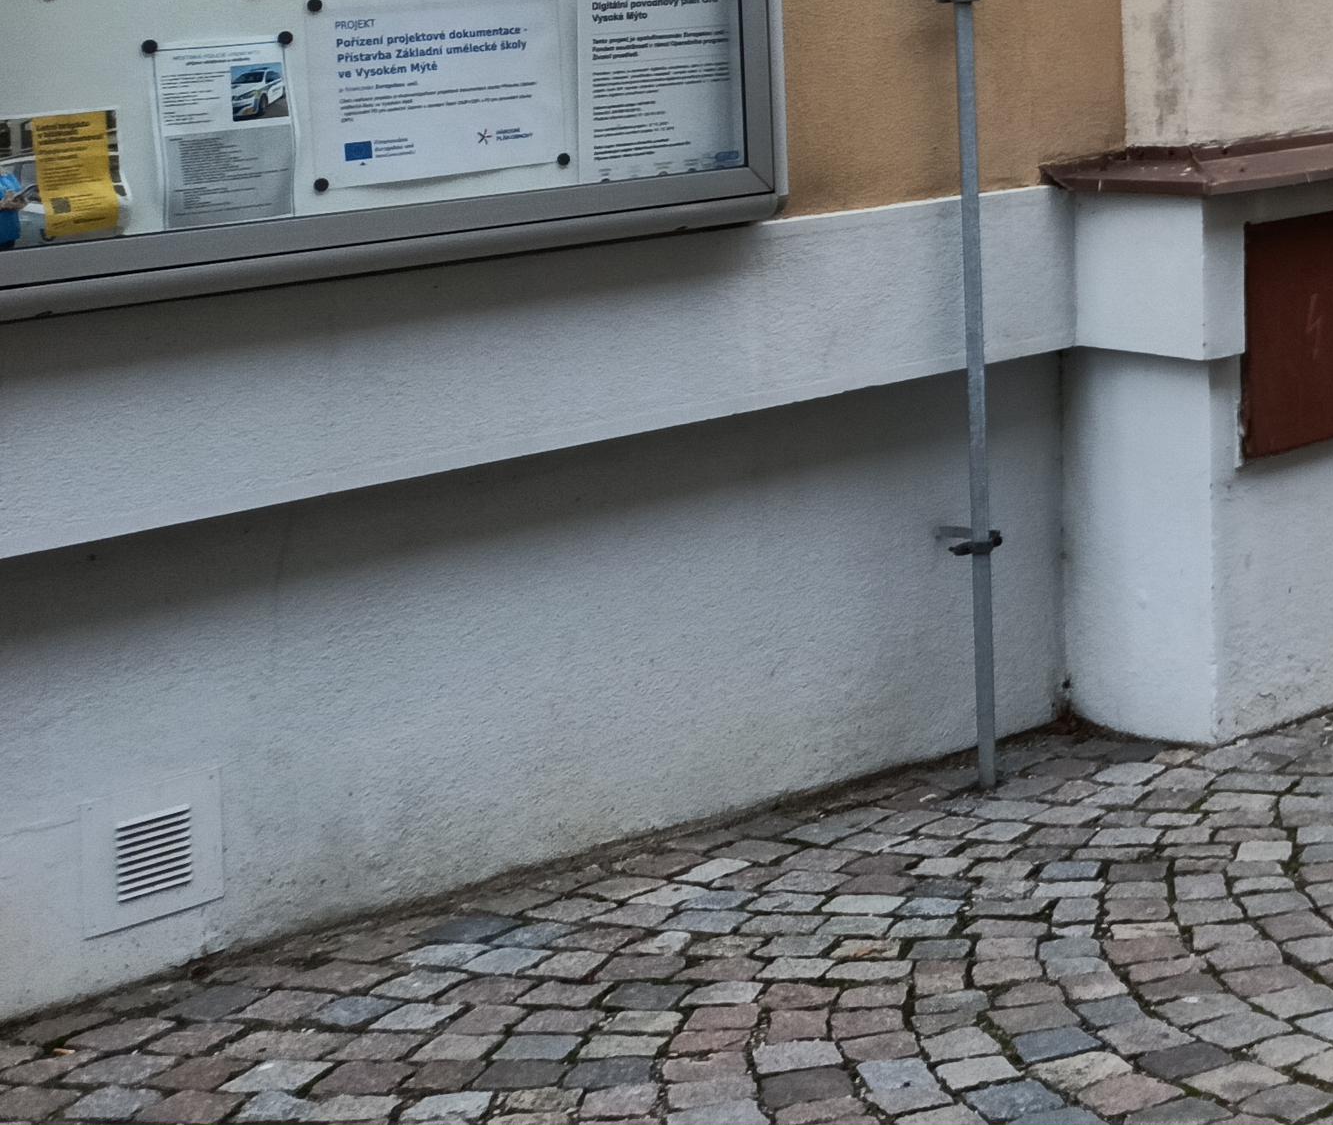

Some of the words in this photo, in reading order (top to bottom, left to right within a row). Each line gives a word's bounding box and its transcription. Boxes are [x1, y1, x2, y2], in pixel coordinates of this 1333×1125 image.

[335, 19, 377, 31] PROJEKT
[626, 11, 648, 21] Mýto
[336, 35, 384, 48] Pořízení
[387, 30, 445, 47] projektové
[449, 27, 521, 39] dokumentace
[337, 51, 392, 63] Přístavba
[395, 45, 443, 59] Základní
[500, 39, 527, 51] školy
[338, 70, 352, 78] ve
[355, 65, 407, 79] Vysokém
[410, 61, 438, 74] Mýtě
